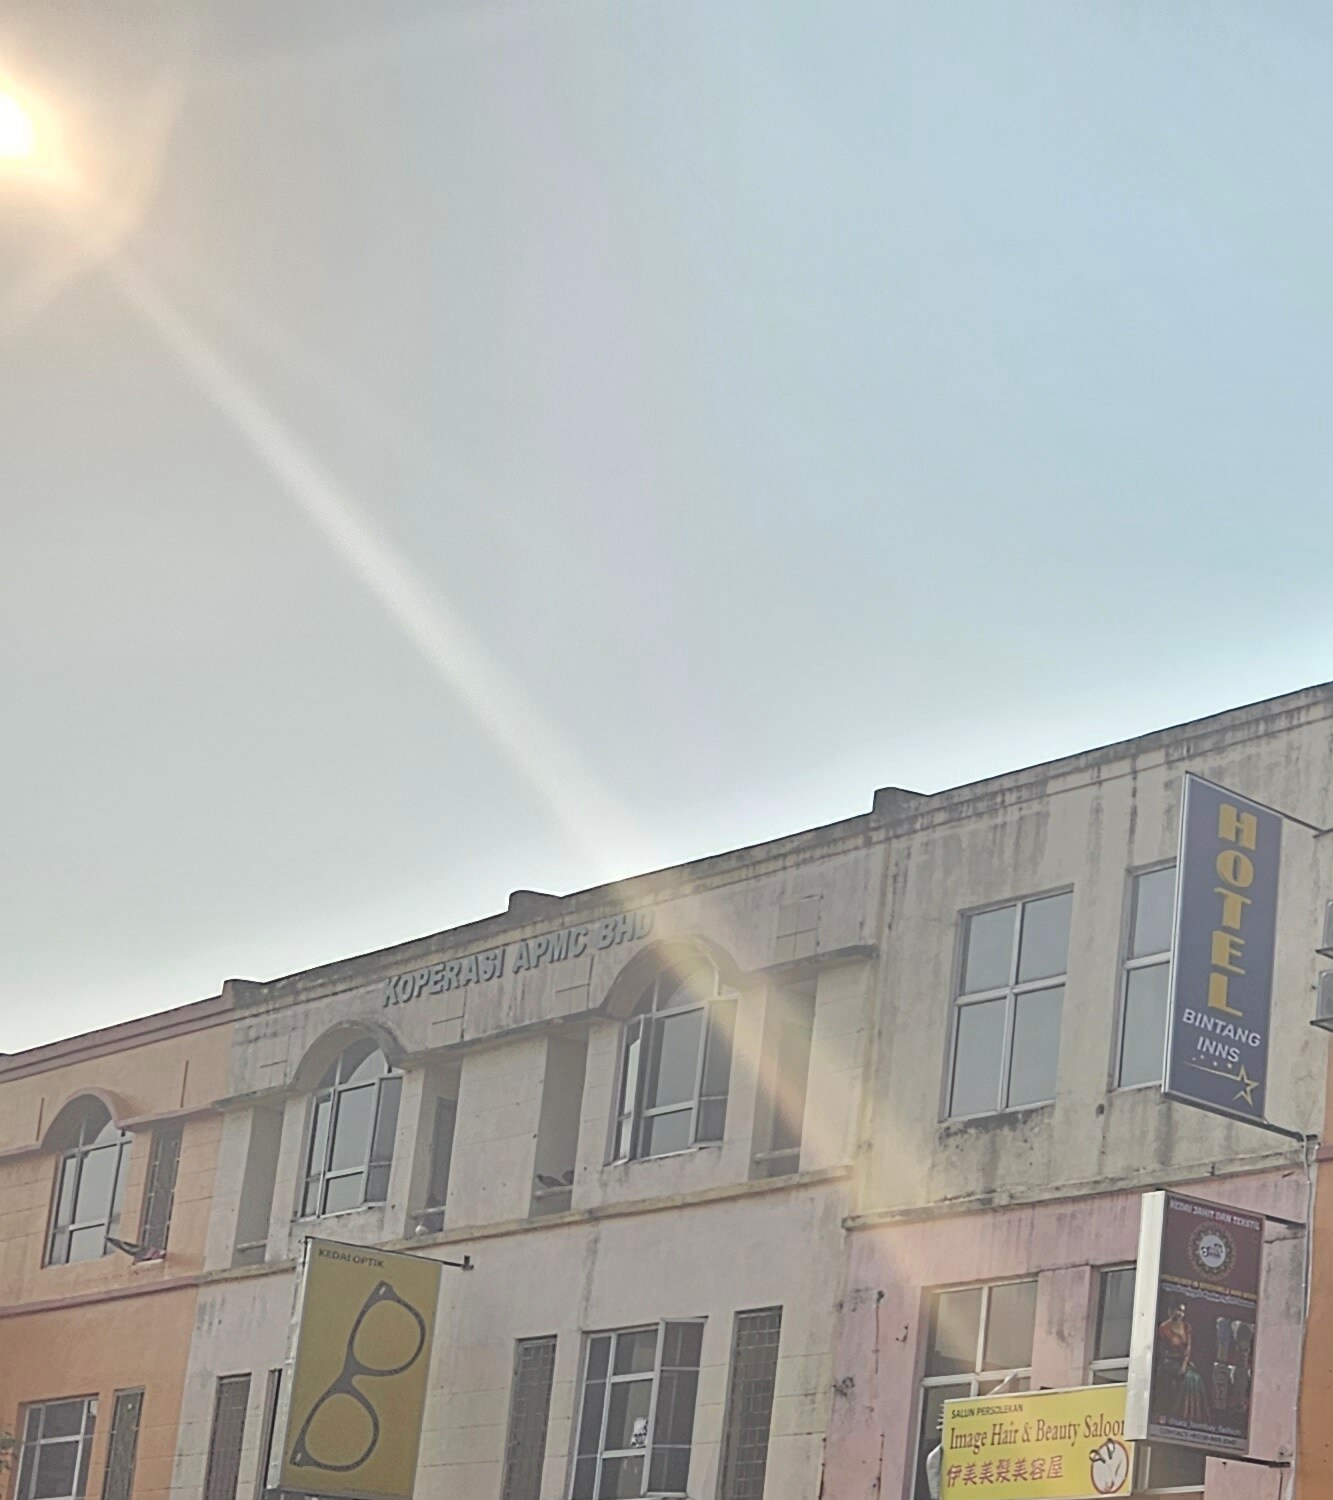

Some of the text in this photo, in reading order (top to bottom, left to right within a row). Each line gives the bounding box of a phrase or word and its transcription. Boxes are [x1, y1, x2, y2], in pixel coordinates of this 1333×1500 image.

[1208, 803, 1257, 1017] HOTEL
[382, 909, 654, 1008] KOPERASI APMC BHD
[1182, 1008, 1261, 1048] BINTANG
[1196, 1036, 1240, 1062] INNS
[318, 1248, 385, 1268] KEDAI OPTIK
[951, 1403, 1024, 1420] SALUN PERSOLEKAN
[949, 1426, 988, 1455] Image
[990, 1420, 1019, 1446] Hair
[1021, 1421, 1031, 1443] &
[1035, 1418, 1080, 1447] Beauty
